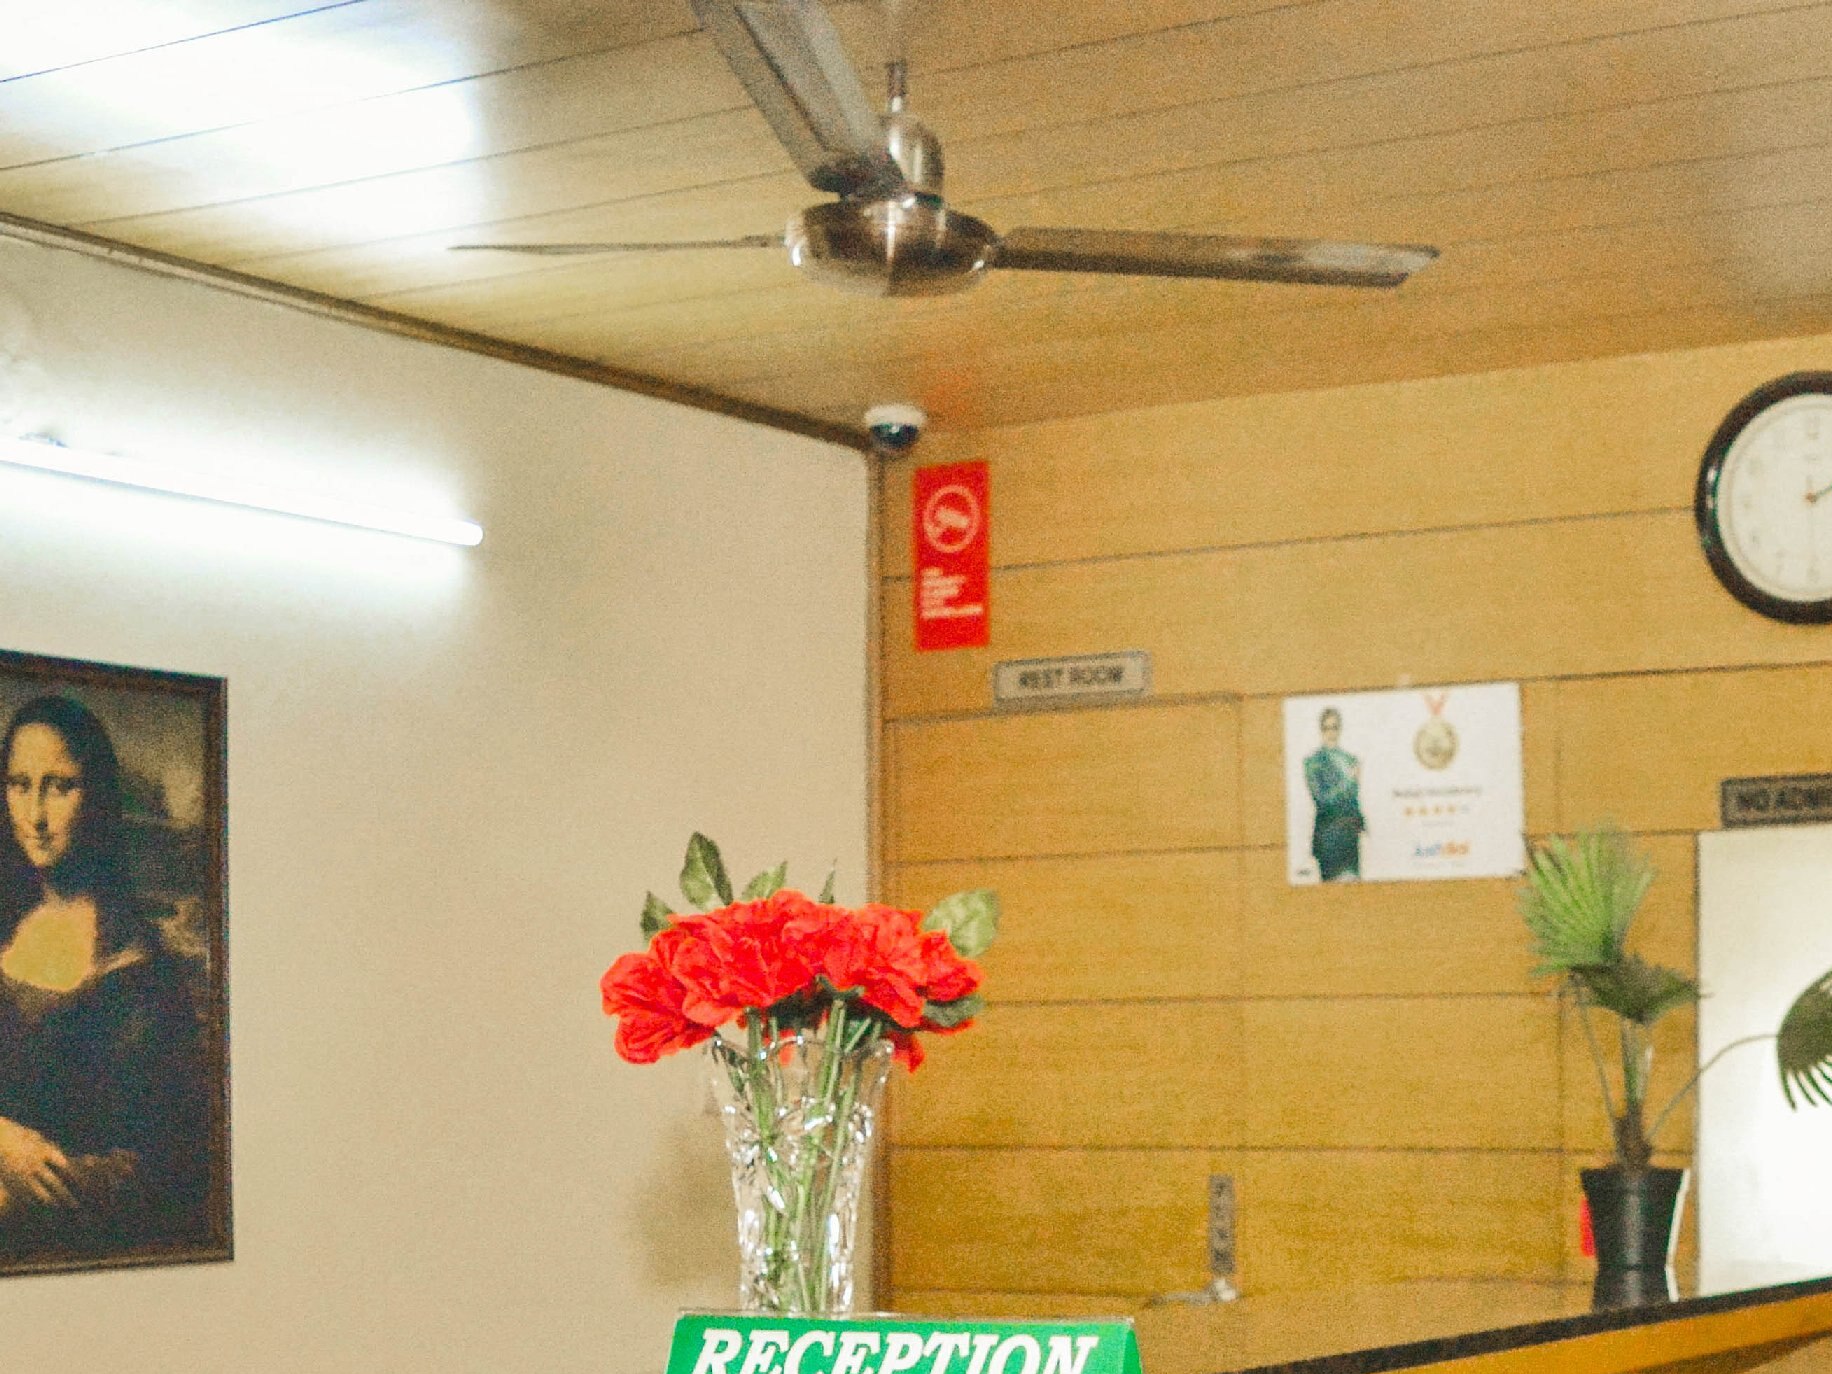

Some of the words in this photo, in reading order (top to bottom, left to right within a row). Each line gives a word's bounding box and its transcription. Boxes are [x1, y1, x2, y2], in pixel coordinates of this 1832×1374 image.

[1018, 668, 1063, 690] REST
[1069, 663, 1123, 686] ROOM
[1736, 790, 1770, 812] NO
